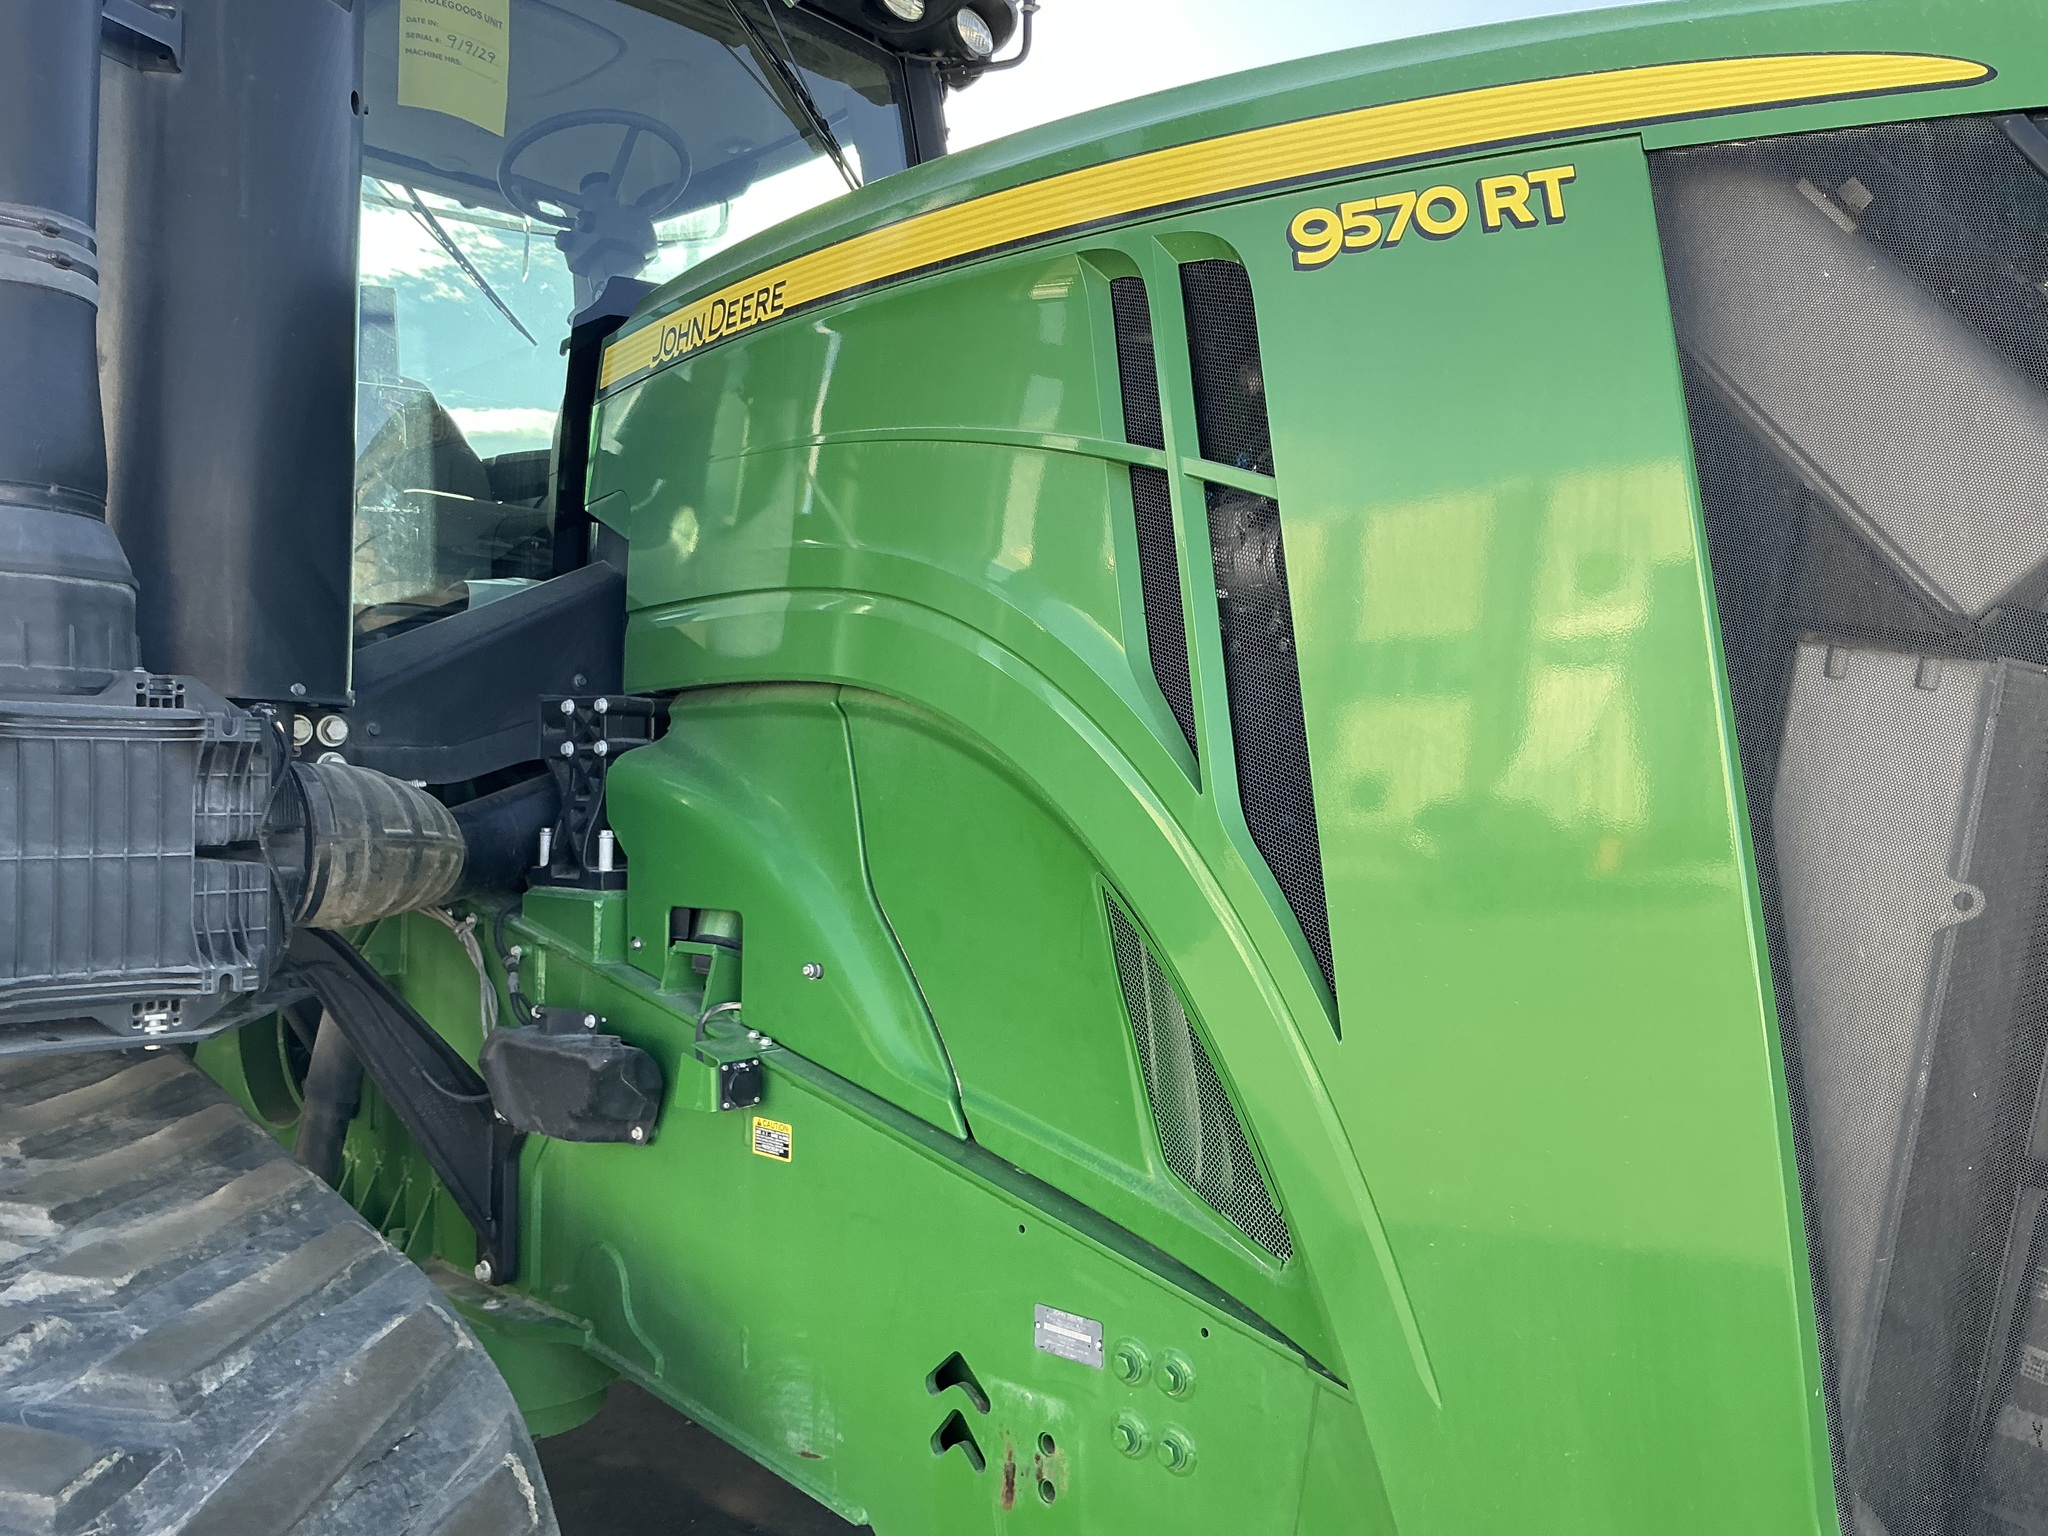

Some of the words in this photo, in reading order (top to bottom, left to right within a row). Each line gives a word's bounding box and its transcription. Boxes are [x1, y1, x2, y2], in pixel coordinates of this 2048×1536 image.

[405, 16, 426, 25] DATE
[427, 19, 439, 27] IN:
[413, 0, 483, 20] LEGOODS
[484, 13, 504, 30] UNIT
[405, 32, 432, 42] SERIAL
[405, 48, 444, 60] MACHINE
[444, 55, 463, 67] HRS:
[1286, 184, 1469, 271] 9570
[1475, 163, 1577, 234] RT
[651, 311, 707, 365] JOHN
[705, 279, 787, 341] DEERE
[762, 1120, 789, 1132] CAUTION
